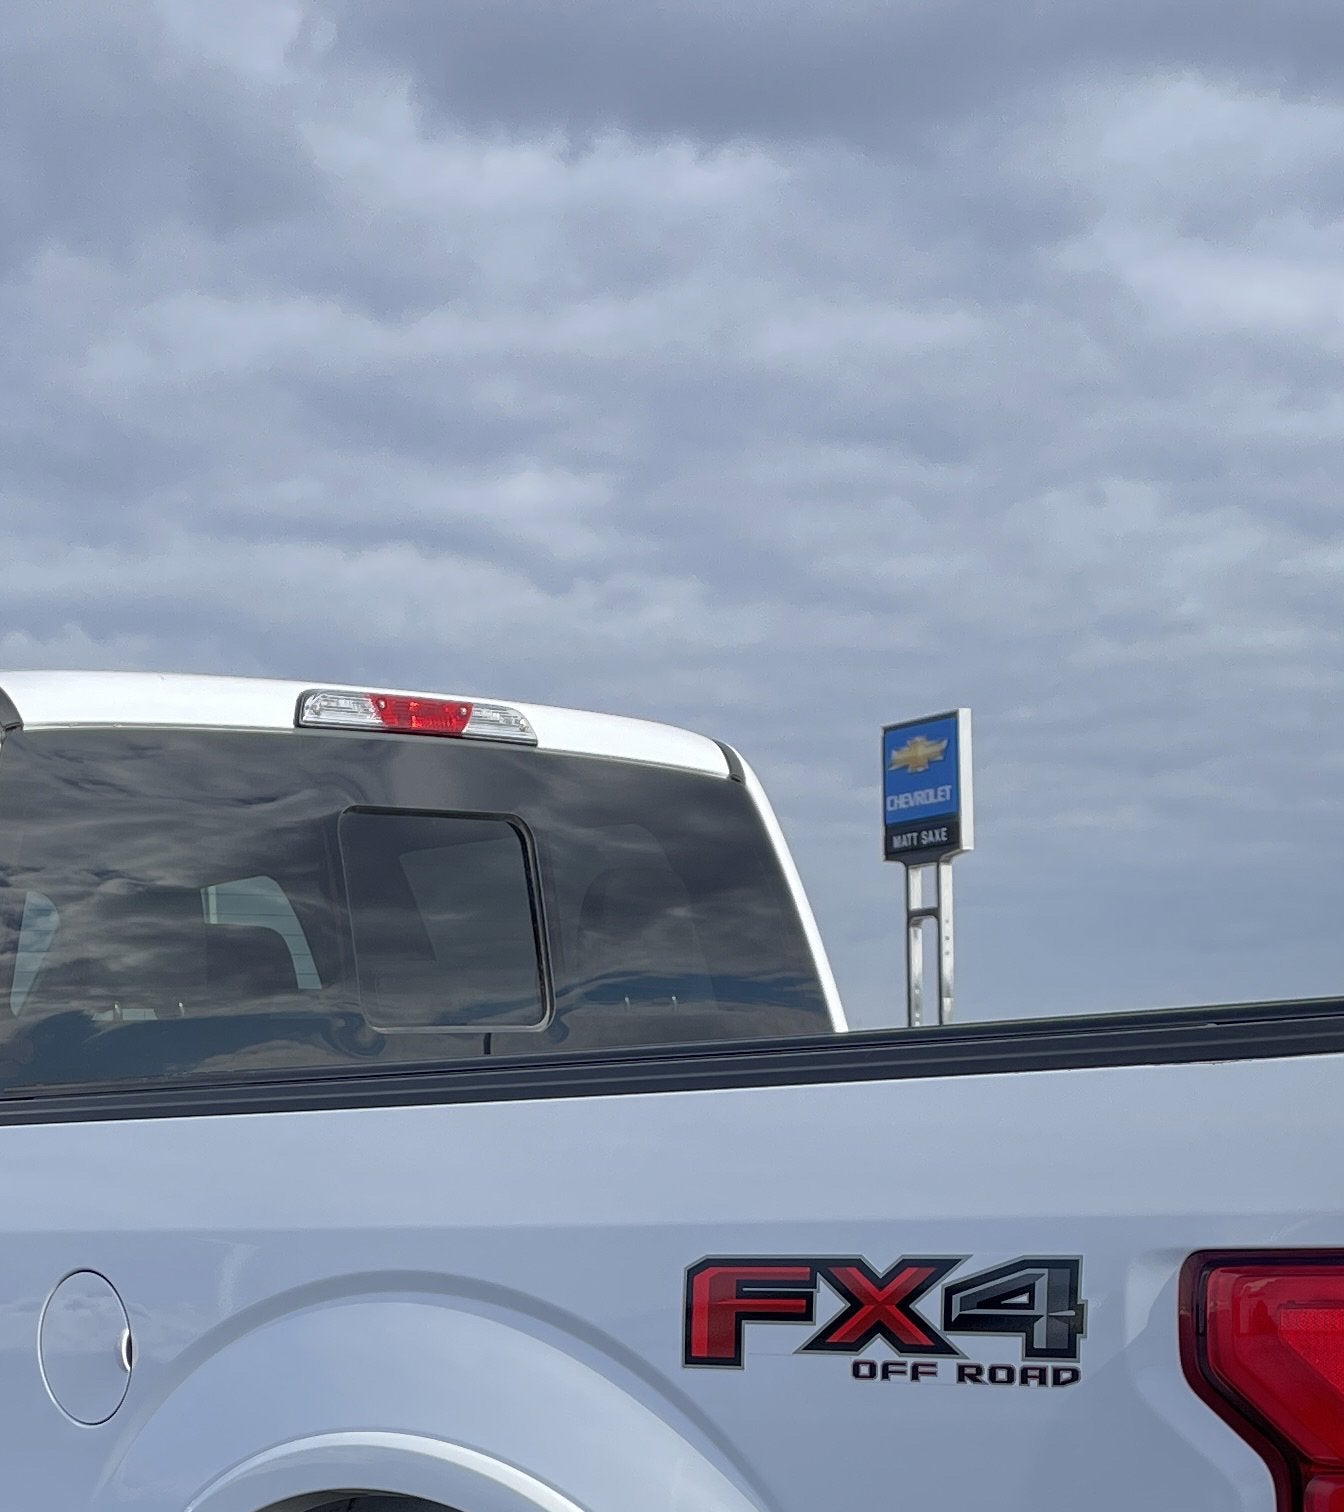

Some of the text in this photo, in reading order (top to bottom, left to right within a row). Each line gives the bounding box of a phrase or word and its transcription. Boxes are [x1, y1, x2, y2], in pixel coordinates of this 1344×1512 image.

[886, 785, 952, 811] CHEVROLET
[892, 826, 949, 849] MATT SAXE
[682, 1254, 1088, 1370] FX4
[850, 1357, 1082, 1388] OFF ROAD
